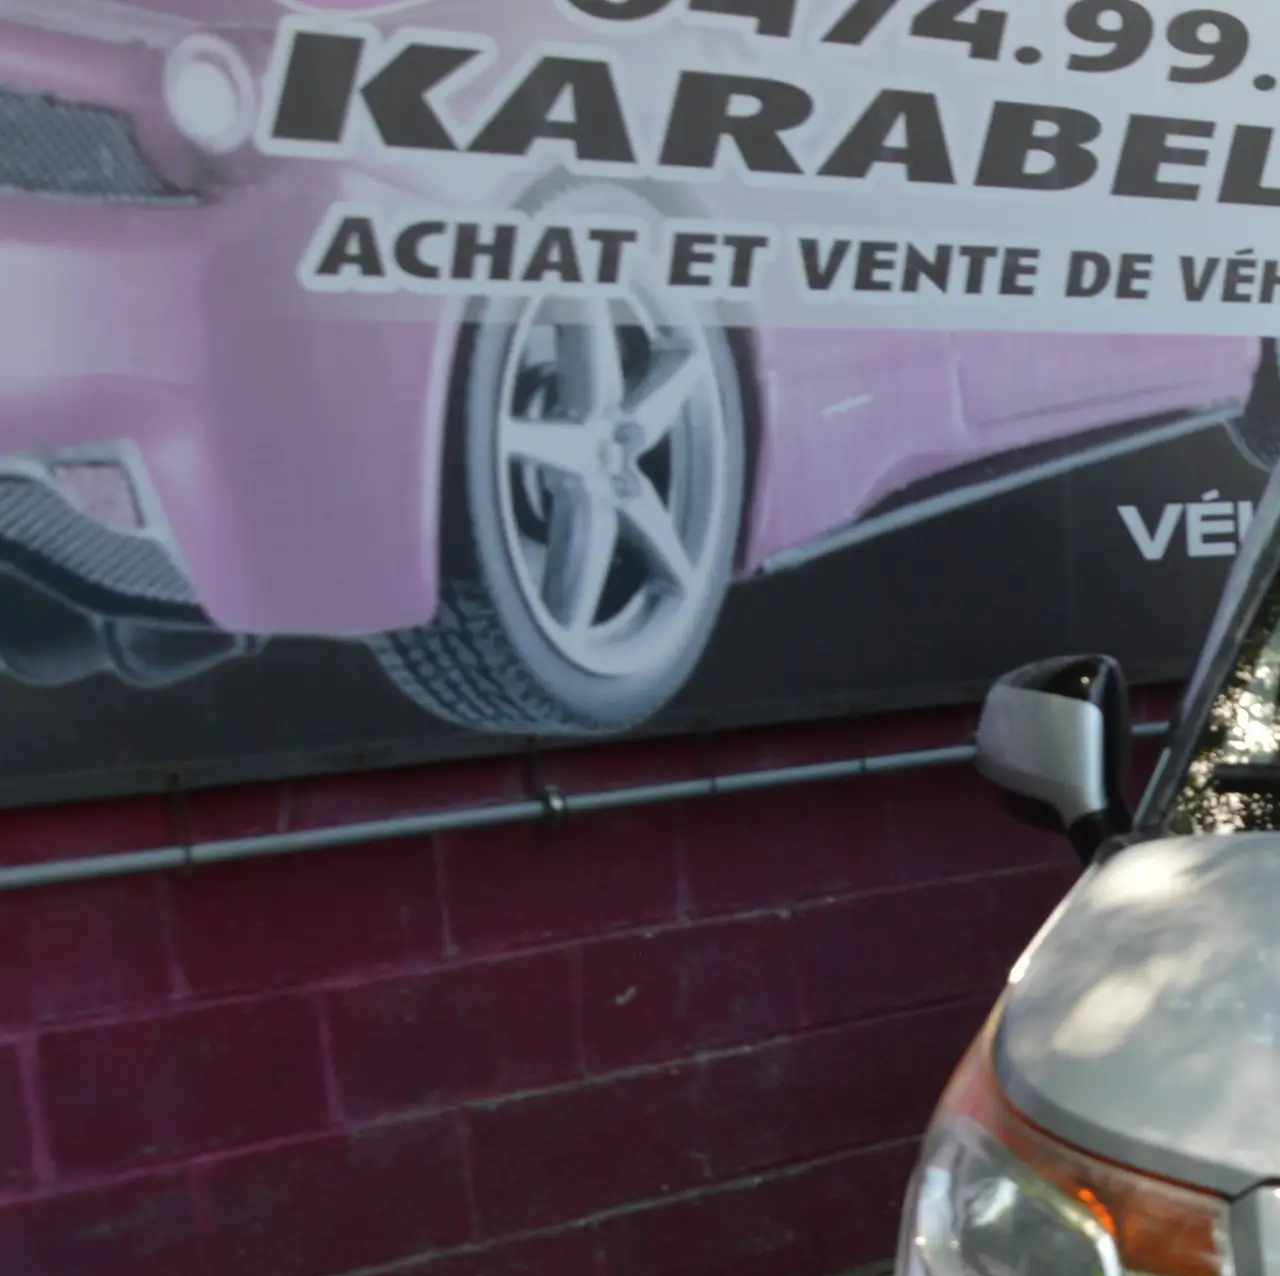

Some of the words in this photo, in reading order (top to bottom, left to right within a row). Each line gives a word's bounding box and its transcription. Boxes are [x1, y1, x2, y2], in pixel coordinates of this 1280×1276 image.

[315, 216, 637, 285] ACHAT
[668, 233, 768, 287] ET
[800, 238, 1040, 296] VENTE
[1064, 250, 1154, 300] DE
